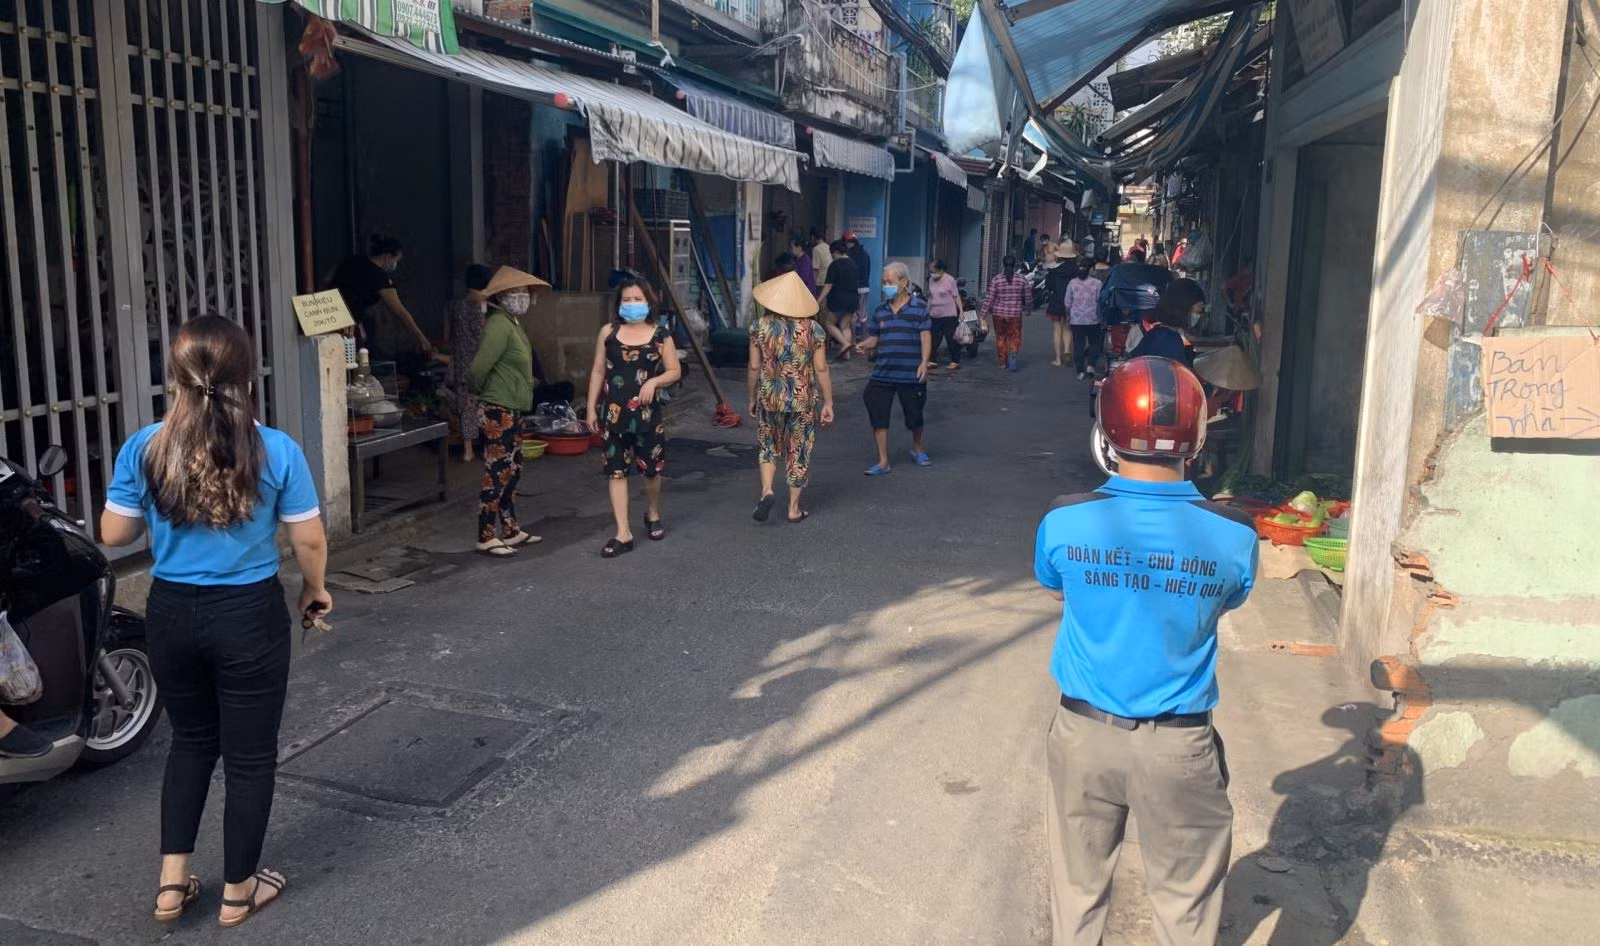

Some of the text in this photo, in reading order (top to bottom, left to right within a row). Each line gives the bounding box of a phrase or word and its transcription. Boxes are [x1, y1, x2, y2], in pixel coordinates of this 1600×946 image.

[1067, 544, 1100, 564] ĐOÀN
[1105, 546, 1132, 567] KẾT
[1148, 550, 1175, 572] CHỦ
[1180, 555, 1217, 578] ĐỘNG
[1085, 568, 1119, 588] SÁNG
[1124, 572, 1150, 592] TẠO
[1165, 576, 1197, 598] HIỆU
[1199, 578, 1226, 600] QUẢ
